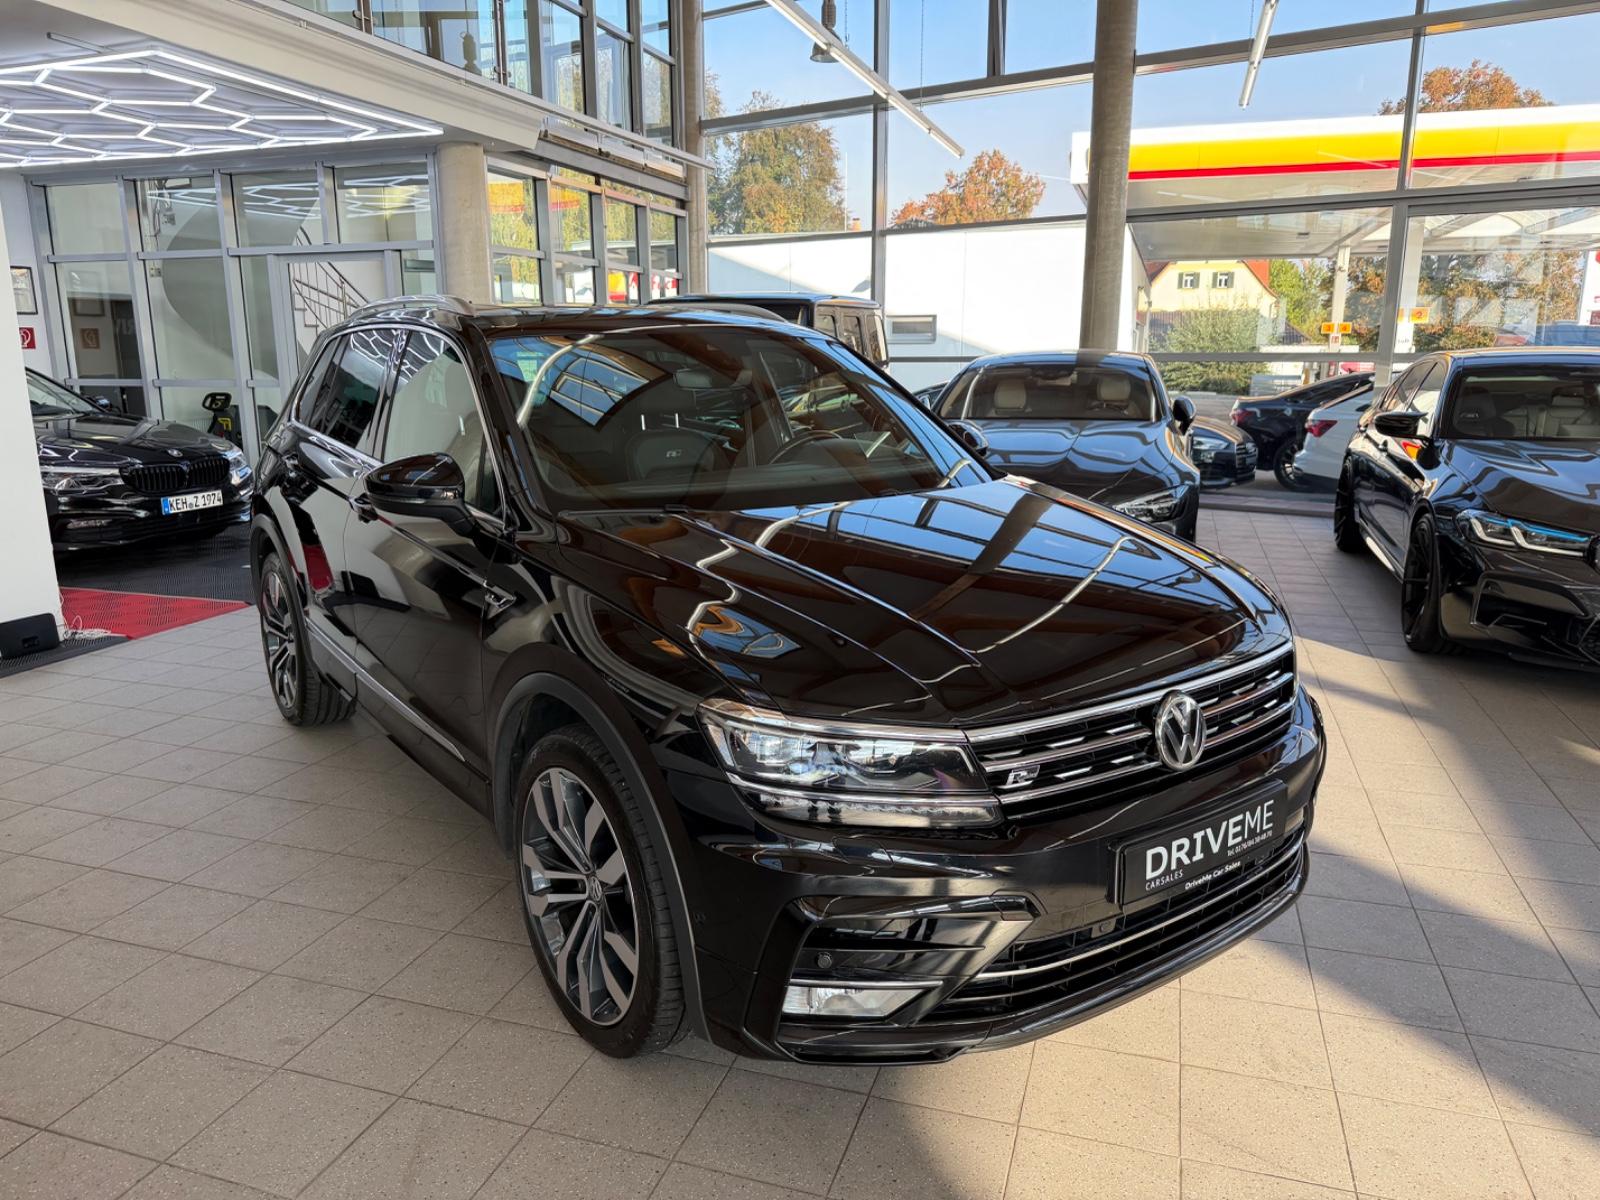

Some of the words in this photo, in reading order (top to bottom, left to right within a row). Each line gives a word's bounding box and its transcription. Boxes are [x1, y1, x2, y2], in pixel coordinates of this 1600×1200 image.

[169, 497, 188, 511] KEH
[194, 495, 200, 508] Z
[1145, 869, 1184, 891] CARSALES
